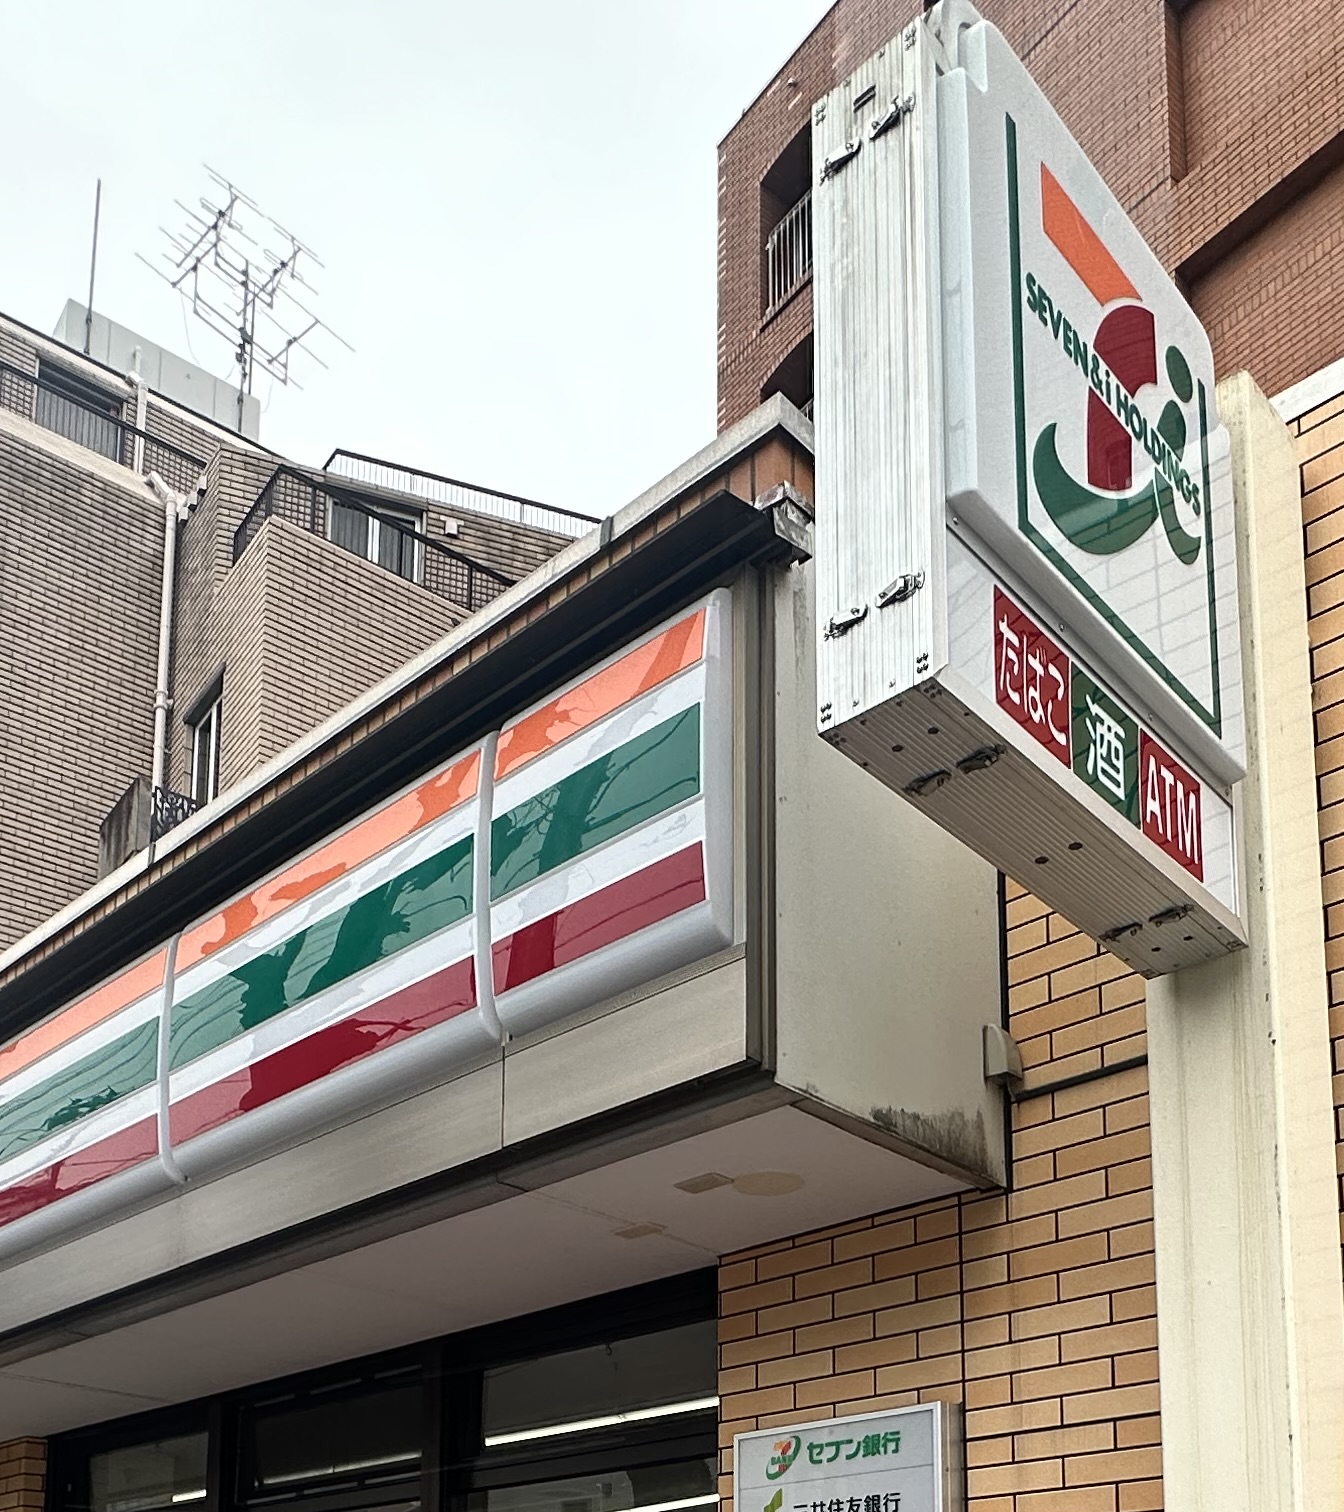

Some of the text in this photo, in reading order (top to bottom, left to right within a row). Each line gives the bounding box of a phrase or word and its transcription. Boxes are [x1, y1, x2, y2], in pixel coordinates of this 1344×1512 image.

[1115, 384, 1201, 518] HOLDINGS
[998, 613, 1067, 746] たばこ
[1085, 693, 1125, 800] 酒
[1146, 754, 1199, 865] ATM
[807, 1431, 901, 1465] セブン銀行
